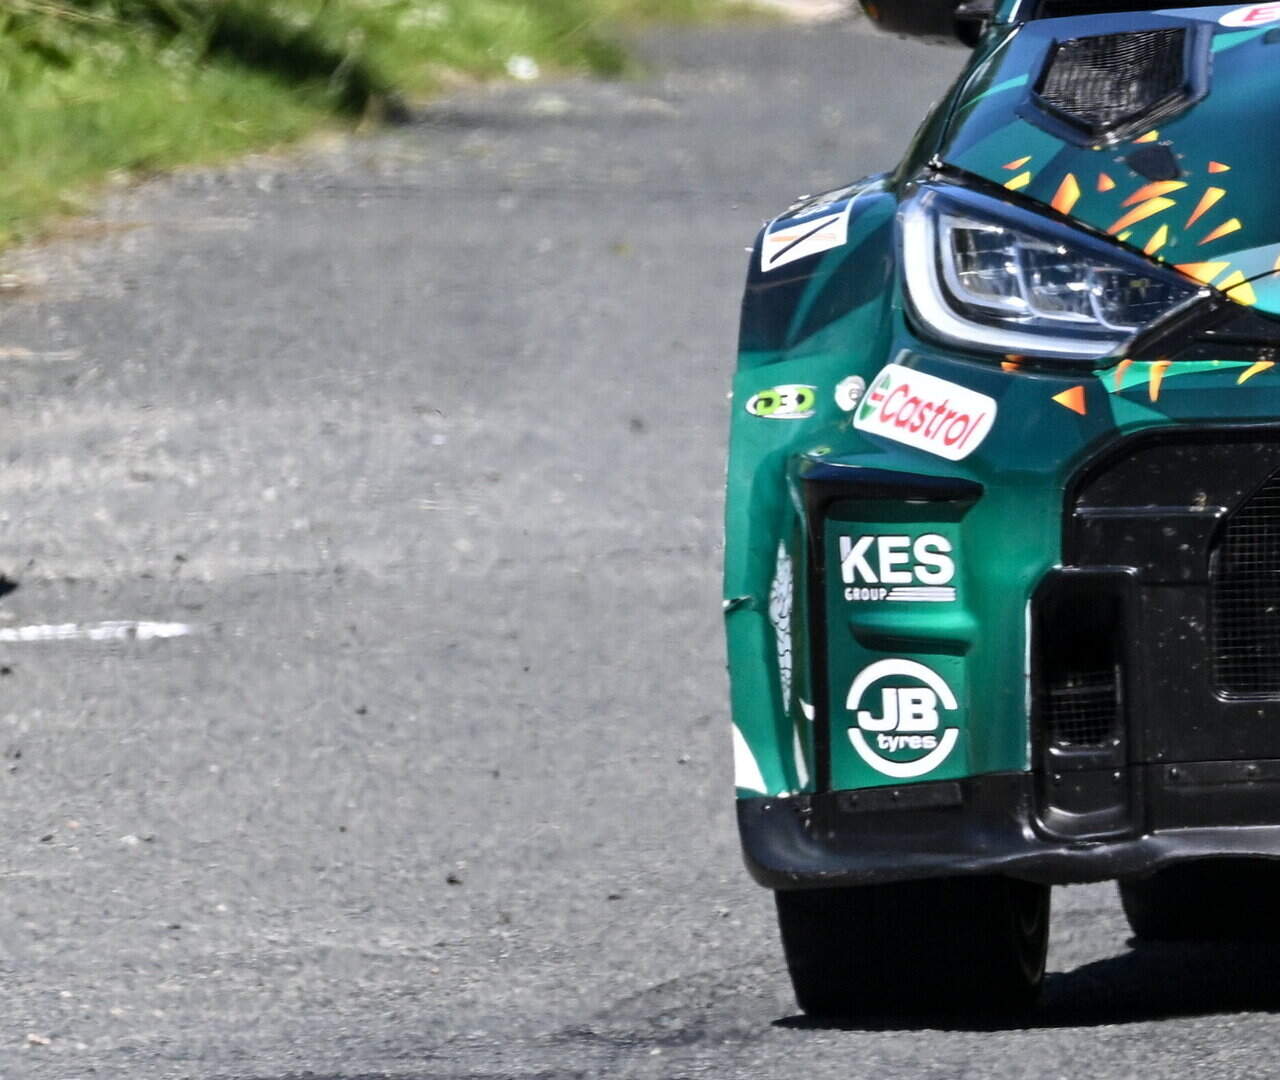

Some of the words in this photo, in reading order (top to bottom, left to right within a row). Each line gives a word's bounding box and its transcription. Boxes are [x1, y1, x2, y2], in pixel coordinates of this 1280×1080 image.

[879, 384, 985, 450] Castrol
[839, 533, 955, 586] KES
[844, 588, 888, 602] GROUP
[856, 687, 939, 732] JB
[877, 731, 938, 754] tyres
